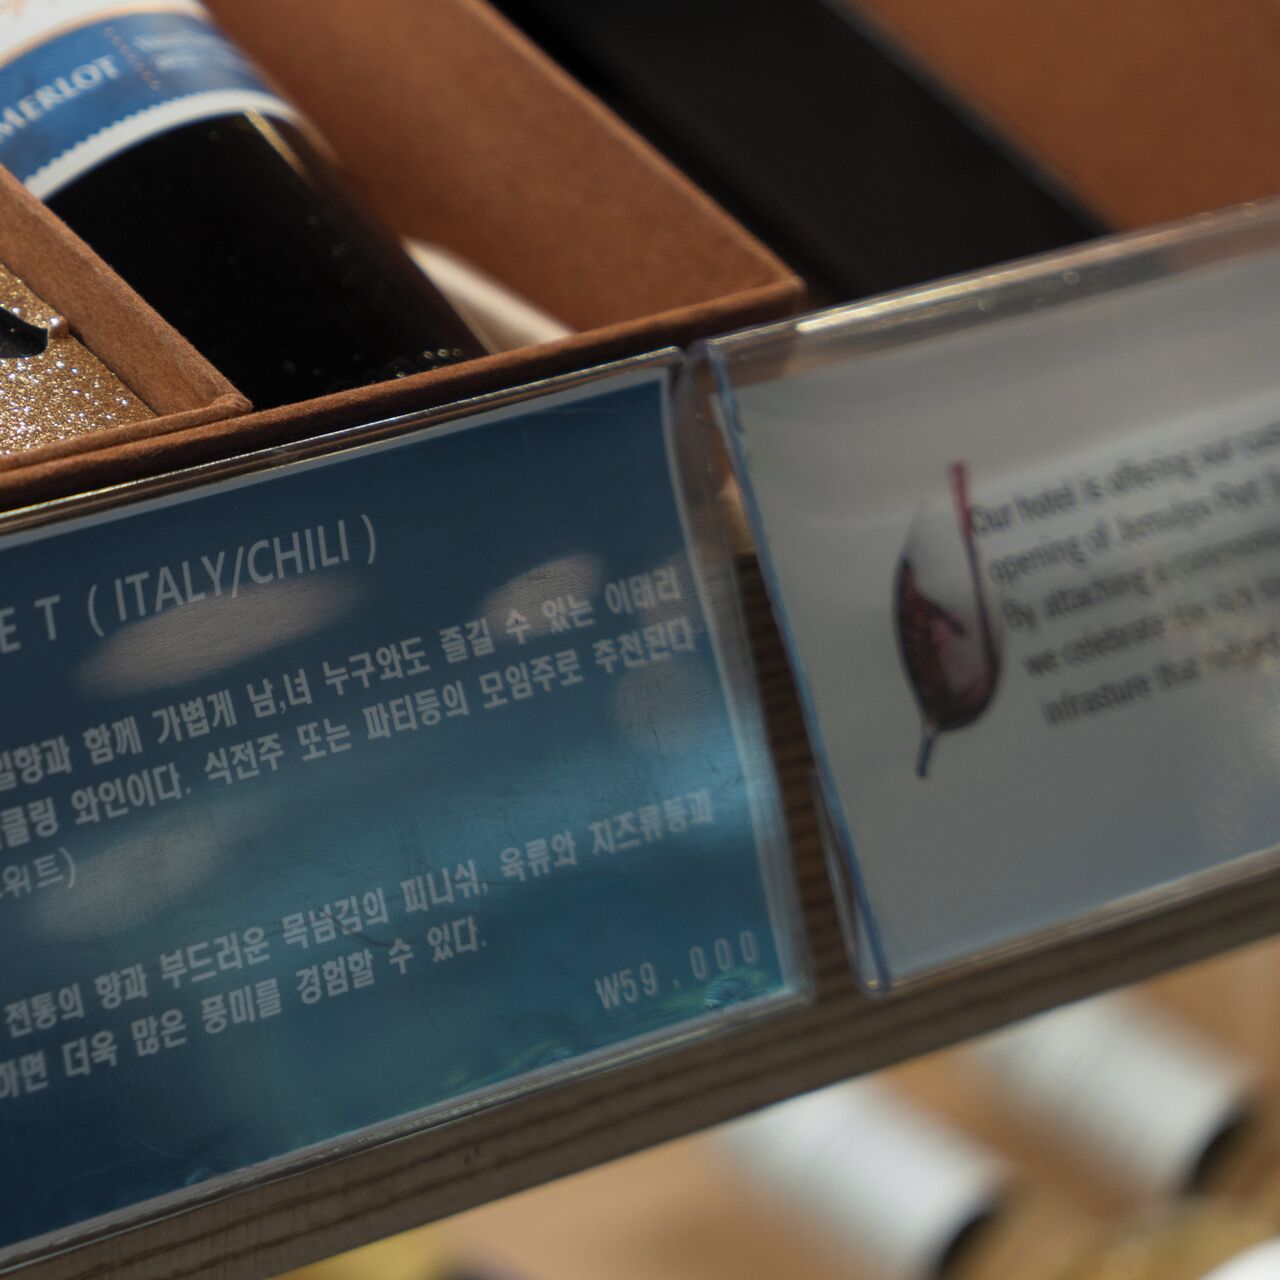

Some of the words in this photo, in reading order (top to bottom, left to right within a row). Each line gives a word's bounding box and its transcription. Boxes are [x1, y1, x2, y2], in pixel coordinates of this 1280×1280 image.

[70, 760, 192, 826] 와인이다.
[203, 733, 285, 786] 식전주
[296, 716, 353, 763] 또는
[362, 679, 471, 741] 파티등의
[480, 646, 584, 710] 모임주로
[592, 615, 697, 677] 추천된다
[83, 715, 144, 767] 함께
[154, 688, 238, 745] 가볍게
[322, 635, 431, 697] 누구와도
[439, 618, 493, 663] 즐길
[505, 608, 532, 644] 수
[543, 591, 596, 634] 있는
[604, 565, 682, 617] 이태리
[3, 982, 85, 1039] 전통의
[94, 962, 149, 1012] 향과
[159, 925, 271, 989] 부드러운
[280, 887, 388, 951] 목넘김의
[400, 859, 490, 913] 피니쉬,
[499, 830, 578, 883] 육류와
[61, 1030, 119, 1079] 더욱
[130, 1007, 187, 1058] 많은
[200, 977, 283, 1035] 풍미를
[294, 947, 376, 1006] 경험할
[387, 936, 415, 975] 수
[426, 915, 488, 963] 있다.
